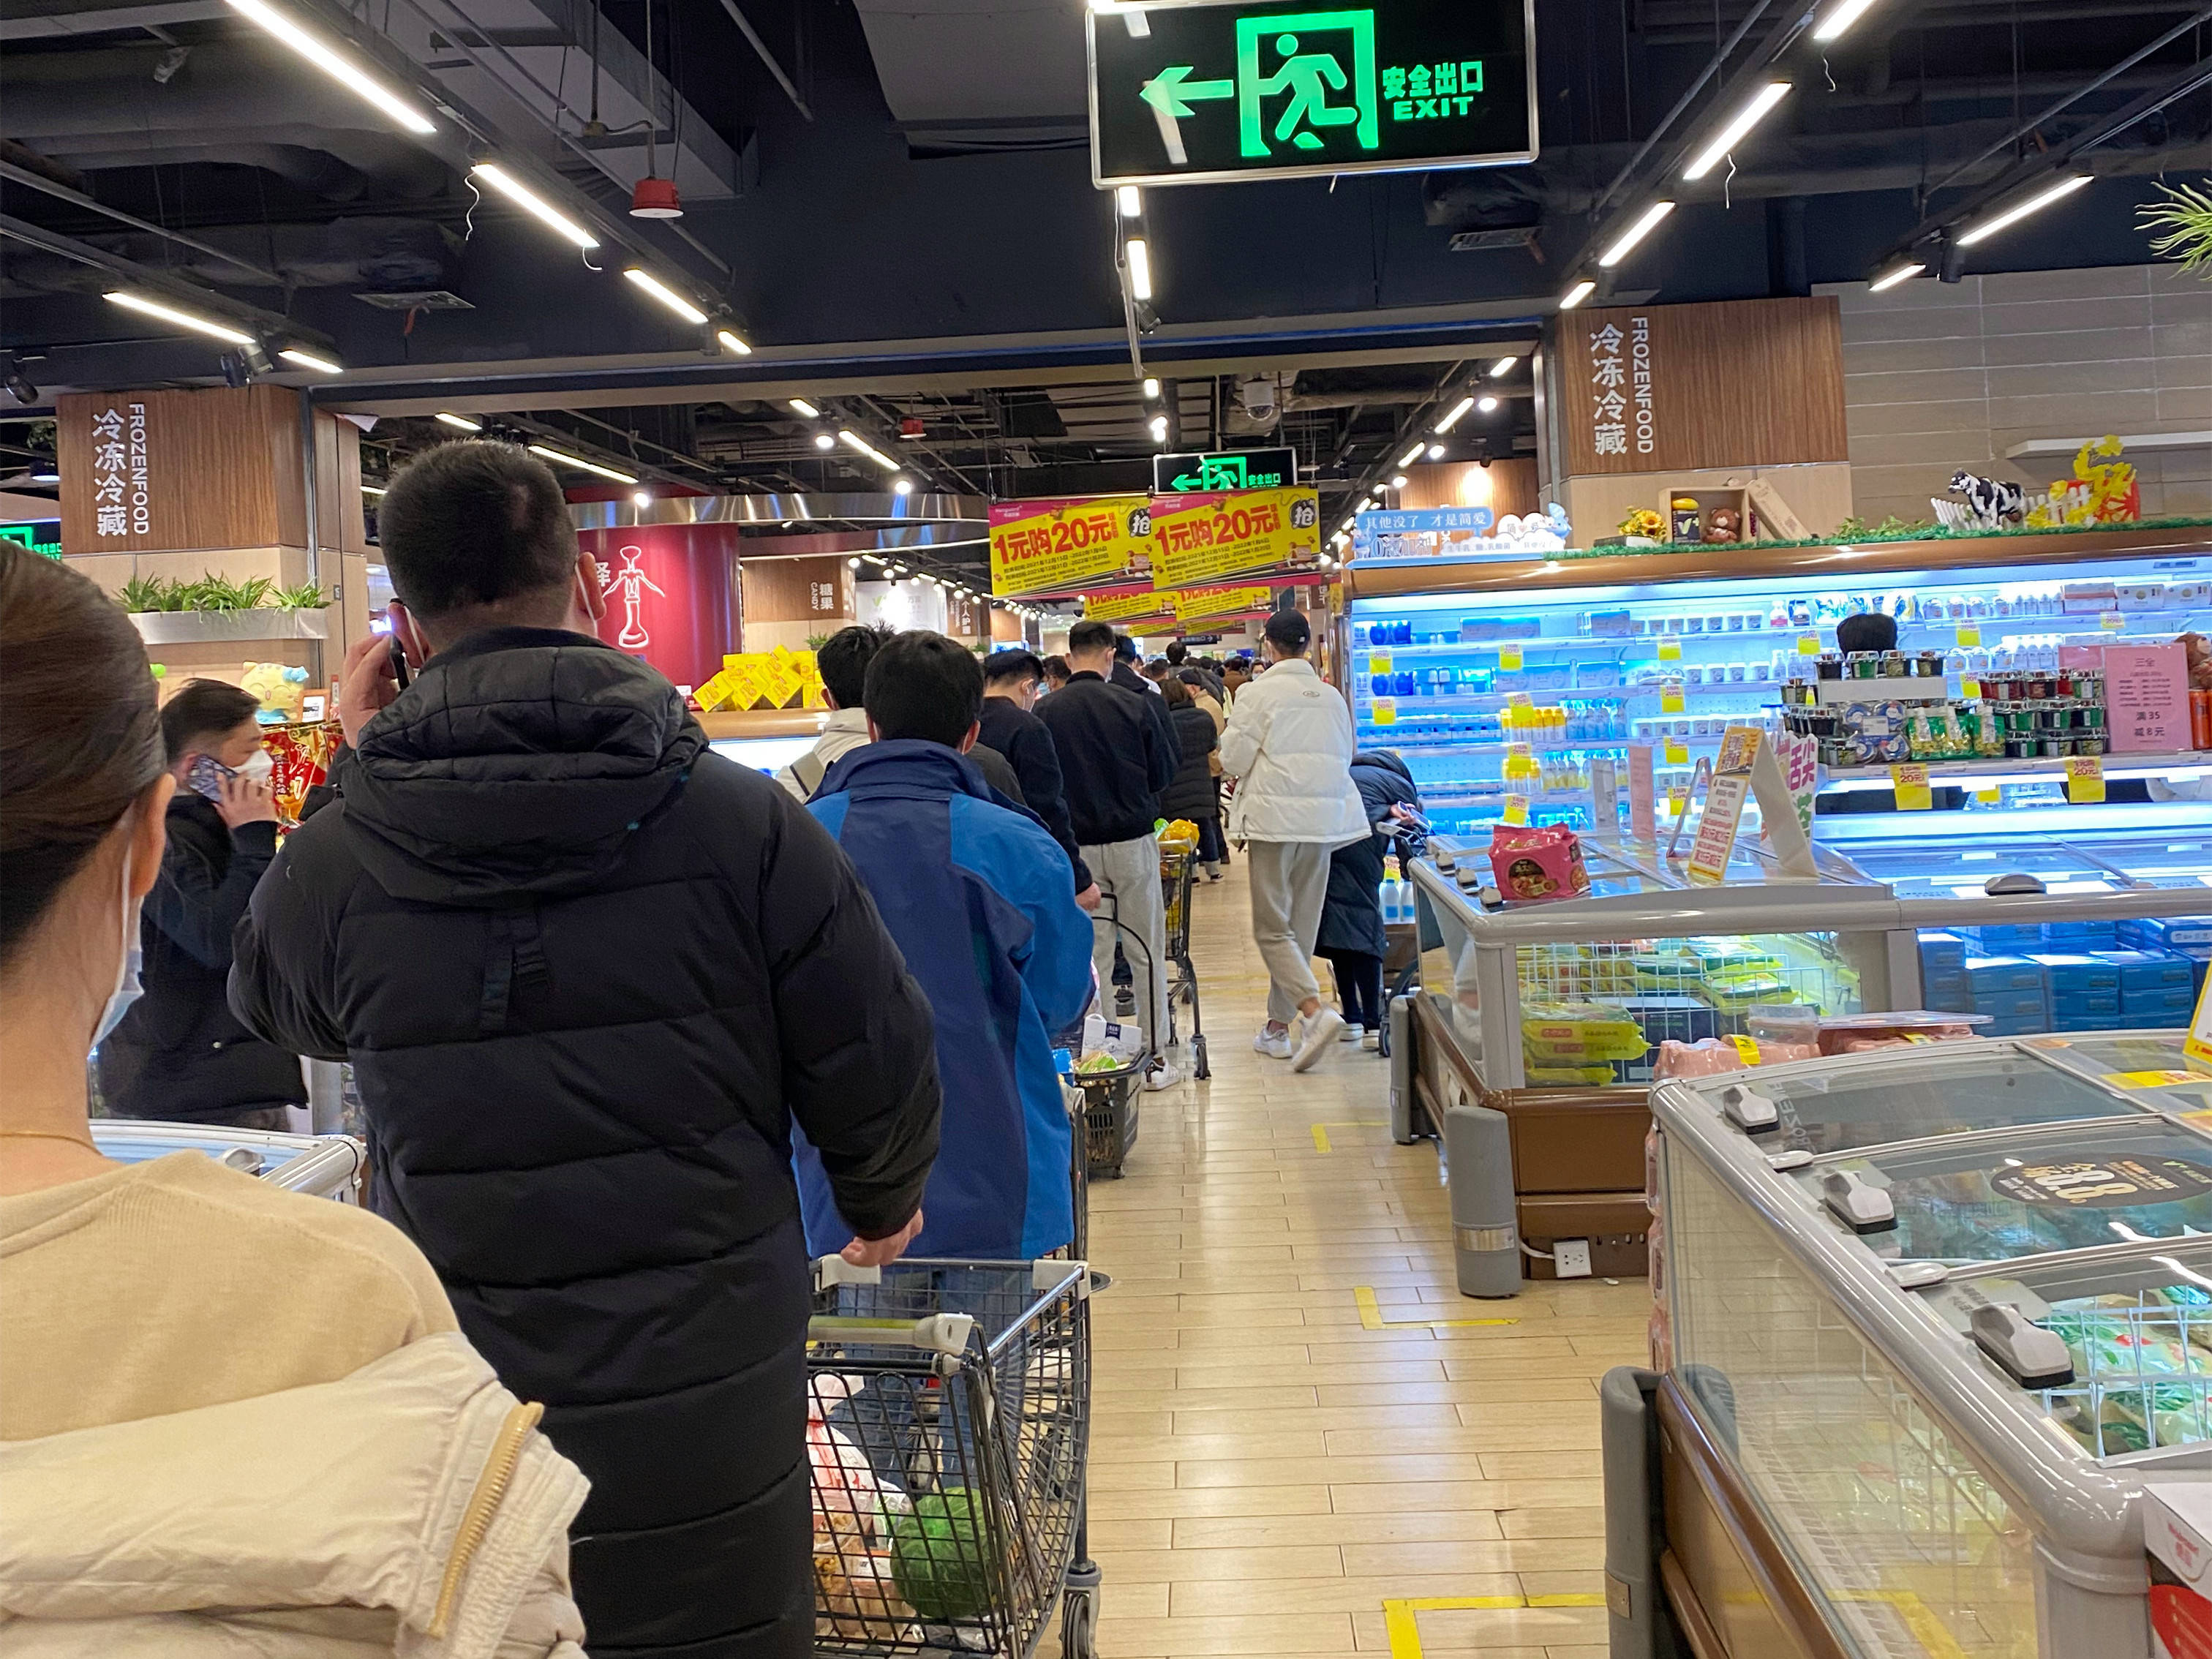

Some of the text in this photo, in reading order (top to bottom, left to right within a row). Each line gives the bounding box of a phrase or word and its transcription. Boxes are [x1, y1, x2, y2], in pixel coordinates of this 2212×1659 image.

[1382, 61, 1483, 99] 安全出口
[1393, 96, 1474, 121] EXIT
[1590, 323, 1628, 456] 冷冻冷藏
[1631, 317, 1654, 454] FROZENFOOD
[92, 408, 127, 537] 冷冻冷藏
[129, 403, 149, 535] FROZENFOOD
[1248, 473, 1281, 486] 安全出口
[1132, 514, 1151, 535] 抢
[1295, 505, 1314, 526] 抢
[1366, 512, 1487, 530] 其他没了 才是简爱
[810, 582, 819, 610] CANDY
[2148, 711, 2161, 720] 35
[2146, 727, 2153, 736] 8
[2154, 726, 2165, 737] 元
